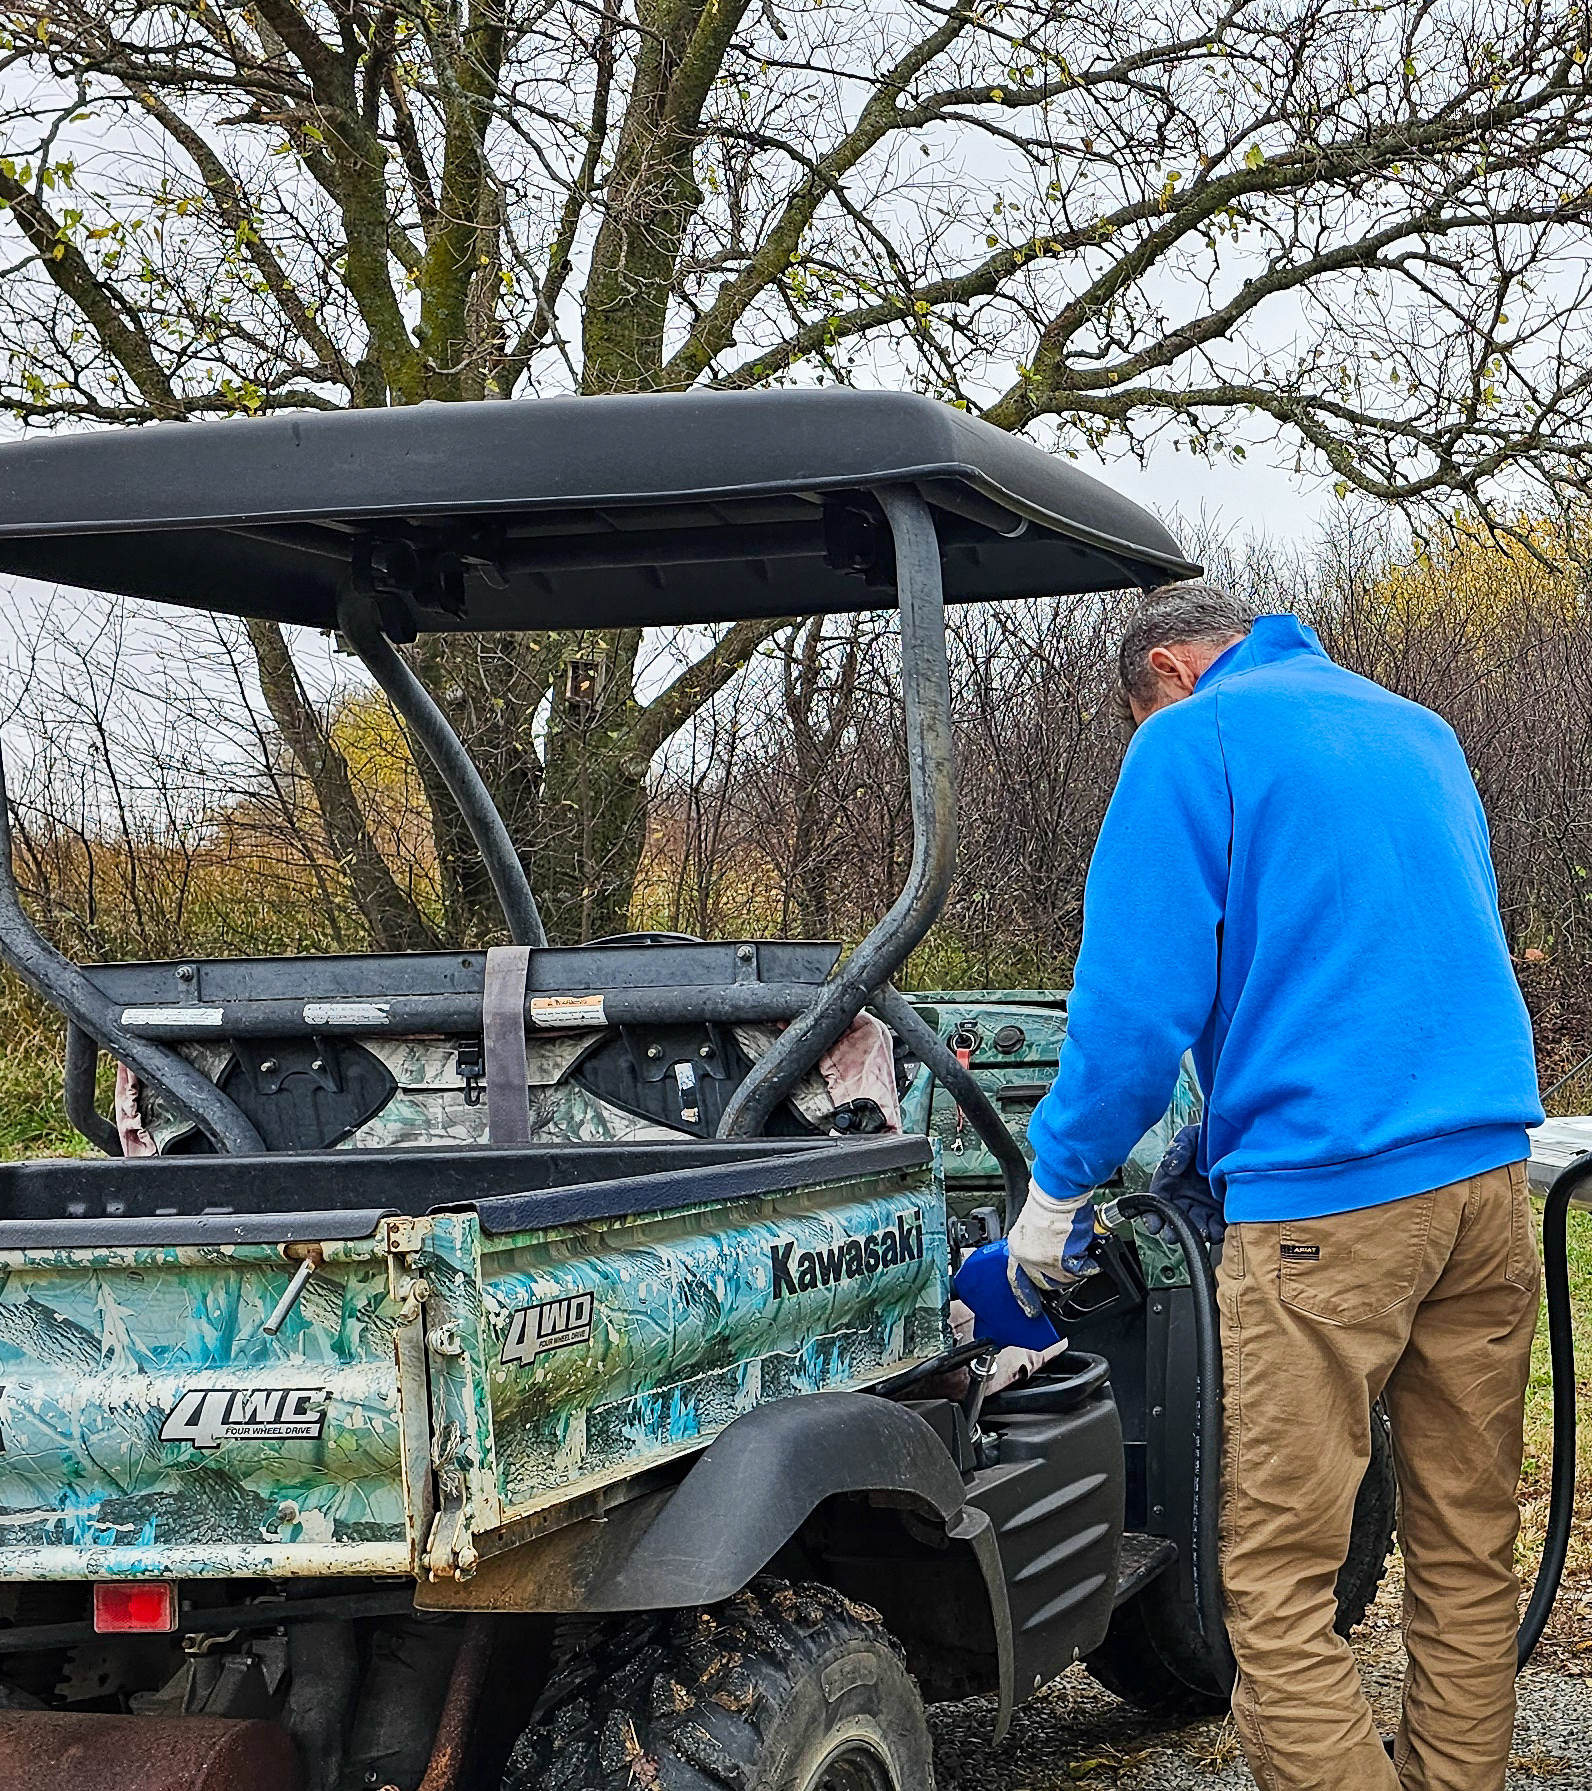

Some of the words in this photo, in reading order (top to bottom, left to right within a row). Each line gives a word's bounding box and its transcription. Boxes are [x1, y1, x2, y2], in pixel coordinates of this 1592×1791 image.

[770, 1206, 924, 1300] Kawasaki
[501, 1292, 593, 1367] 4WD
[225, 1426, 250, 1435] FOUR
[252, 1426, 283, 1435] WHEEL
[285, 1426, 312, 1435] DRIVE
